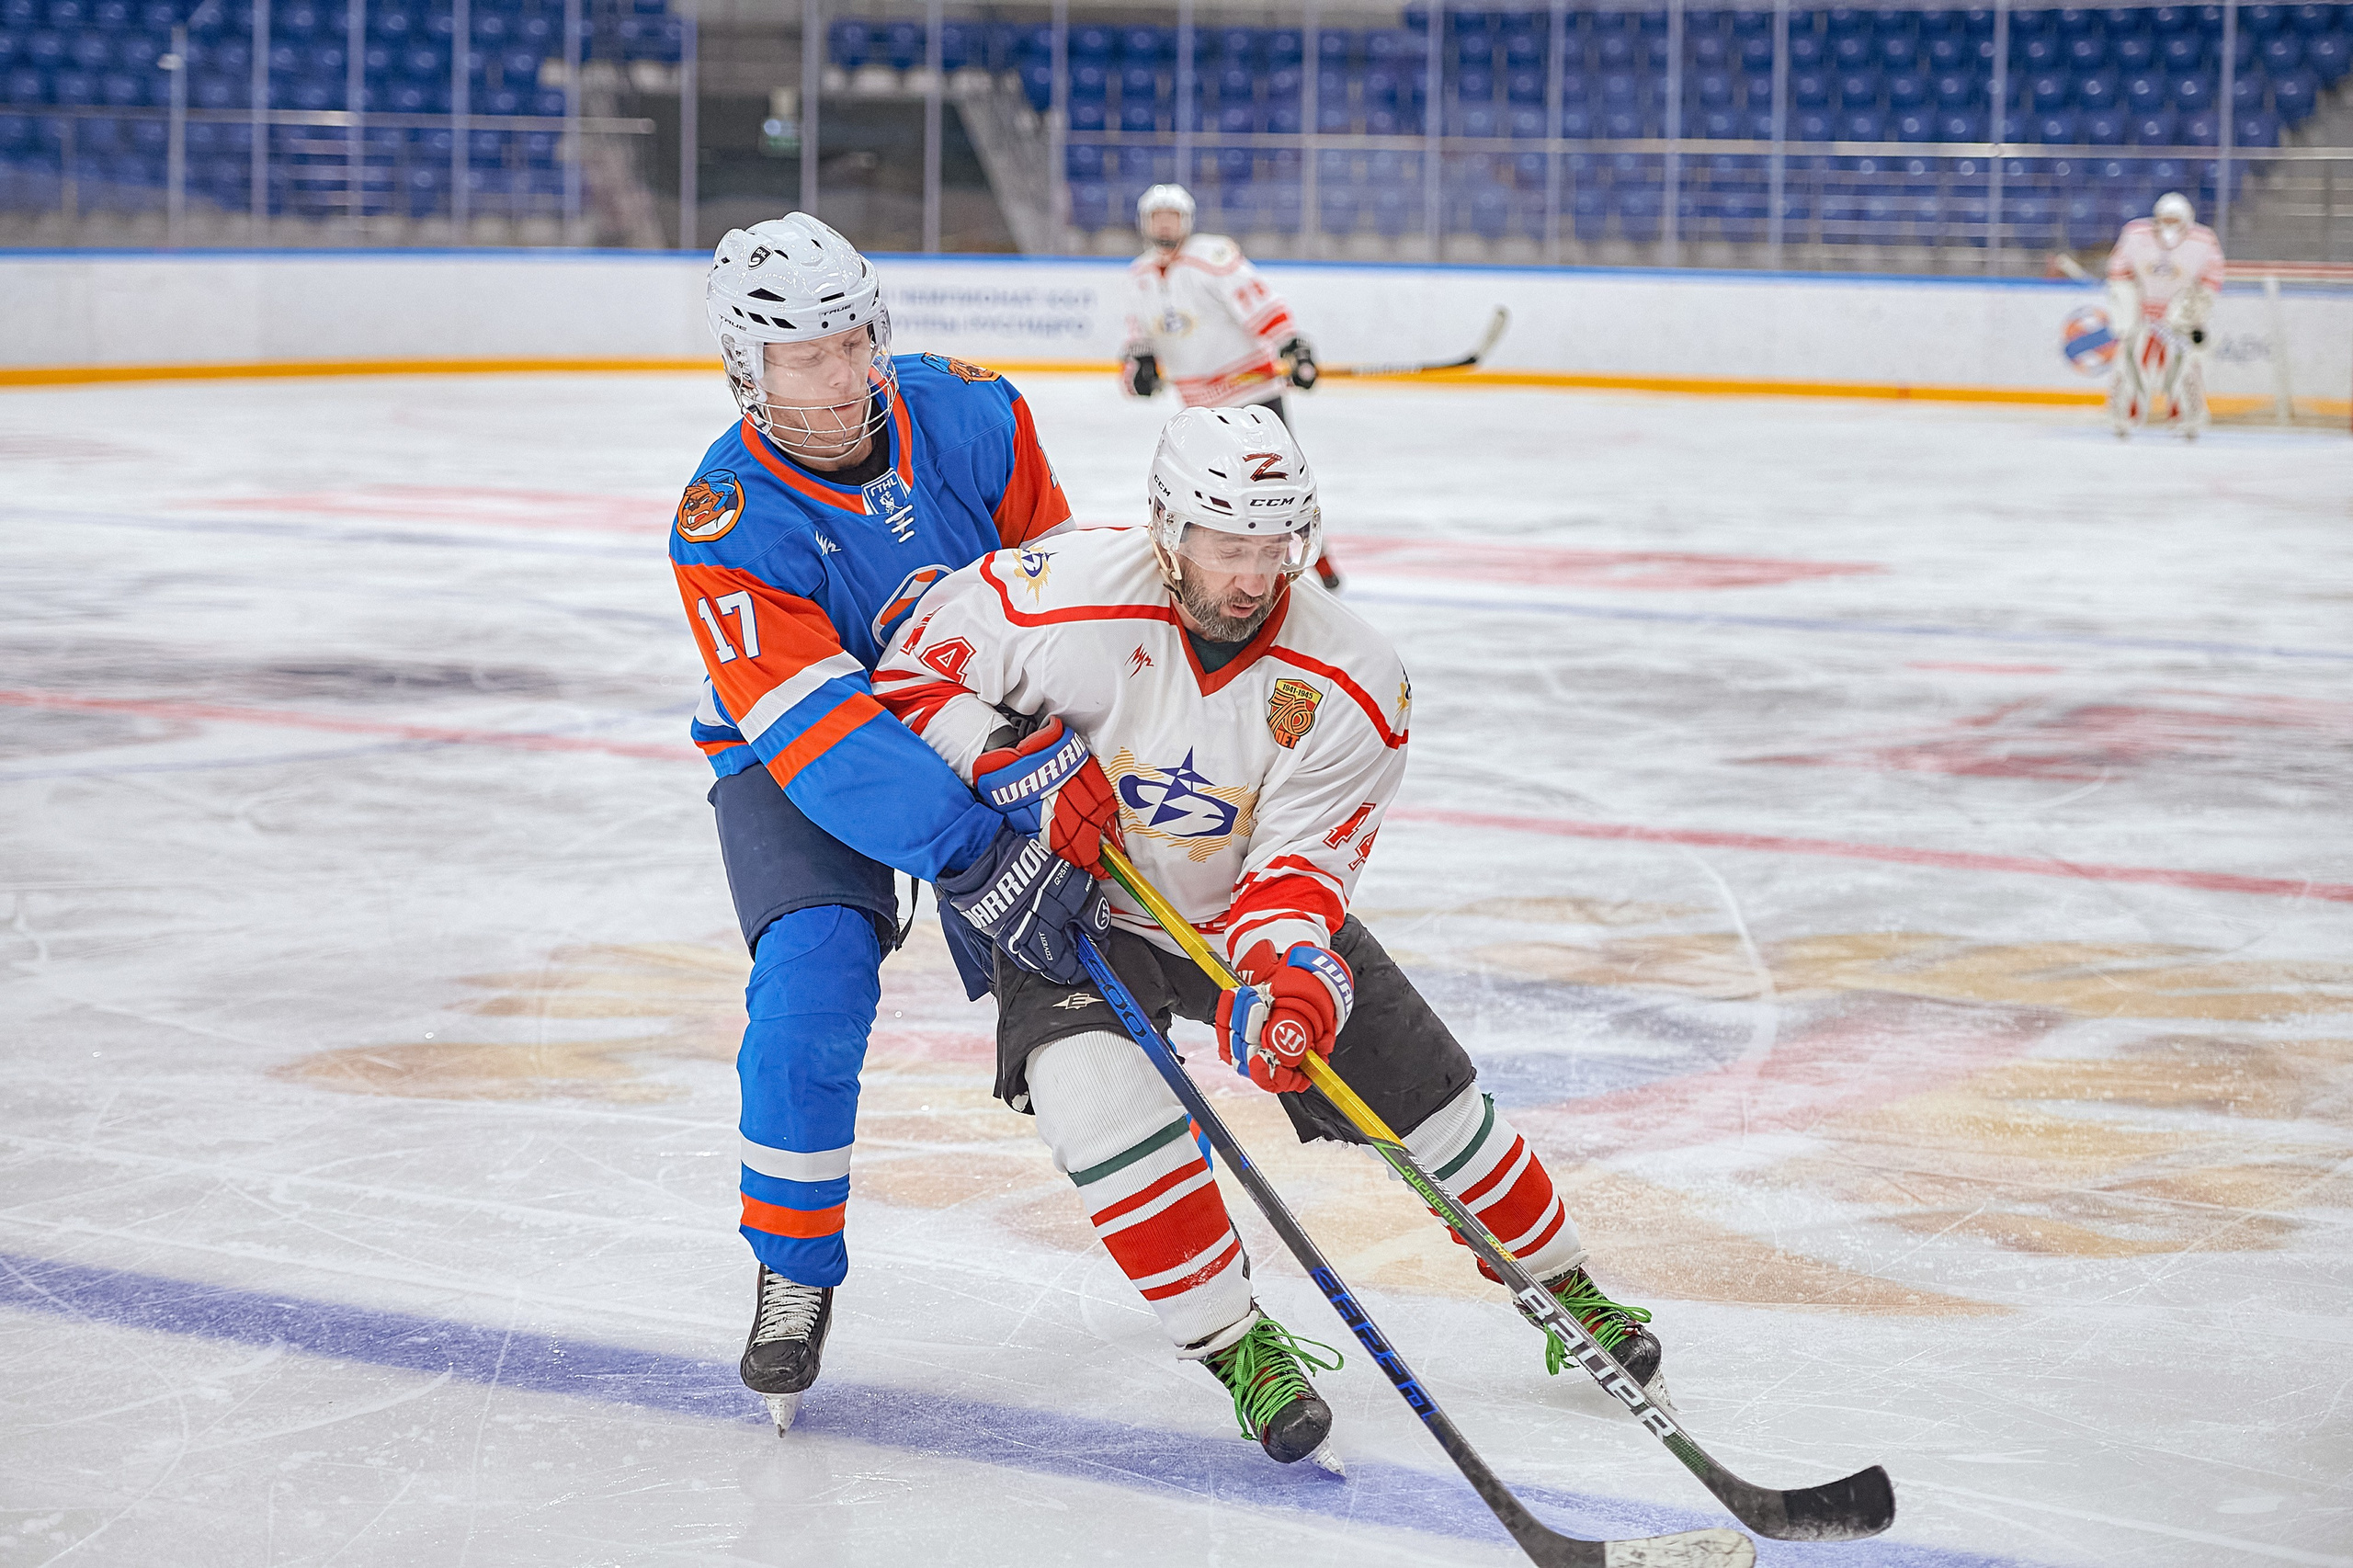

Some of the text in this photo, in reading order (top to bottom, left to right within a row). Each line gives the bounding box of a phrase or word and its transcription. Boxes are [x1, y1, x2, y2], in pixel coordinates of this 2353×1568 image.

[718, 313, 747, 332] TRUE
[821, 303, 852, 317] TRUE
[1243, 452, 1289, 483] Z
[1154, 473, 1171, 497] CCM
[1249, 496, 1295, 506] CCM
[697, 590, 762, 665] 17
[1282, 683, 1313, 700] 1941-1945
[1038, 931, 1054, 961] COVERT
[1408, 1154, 1460, 1201] BAUER
[1517, 1286, 1679, 1442] BAUER
